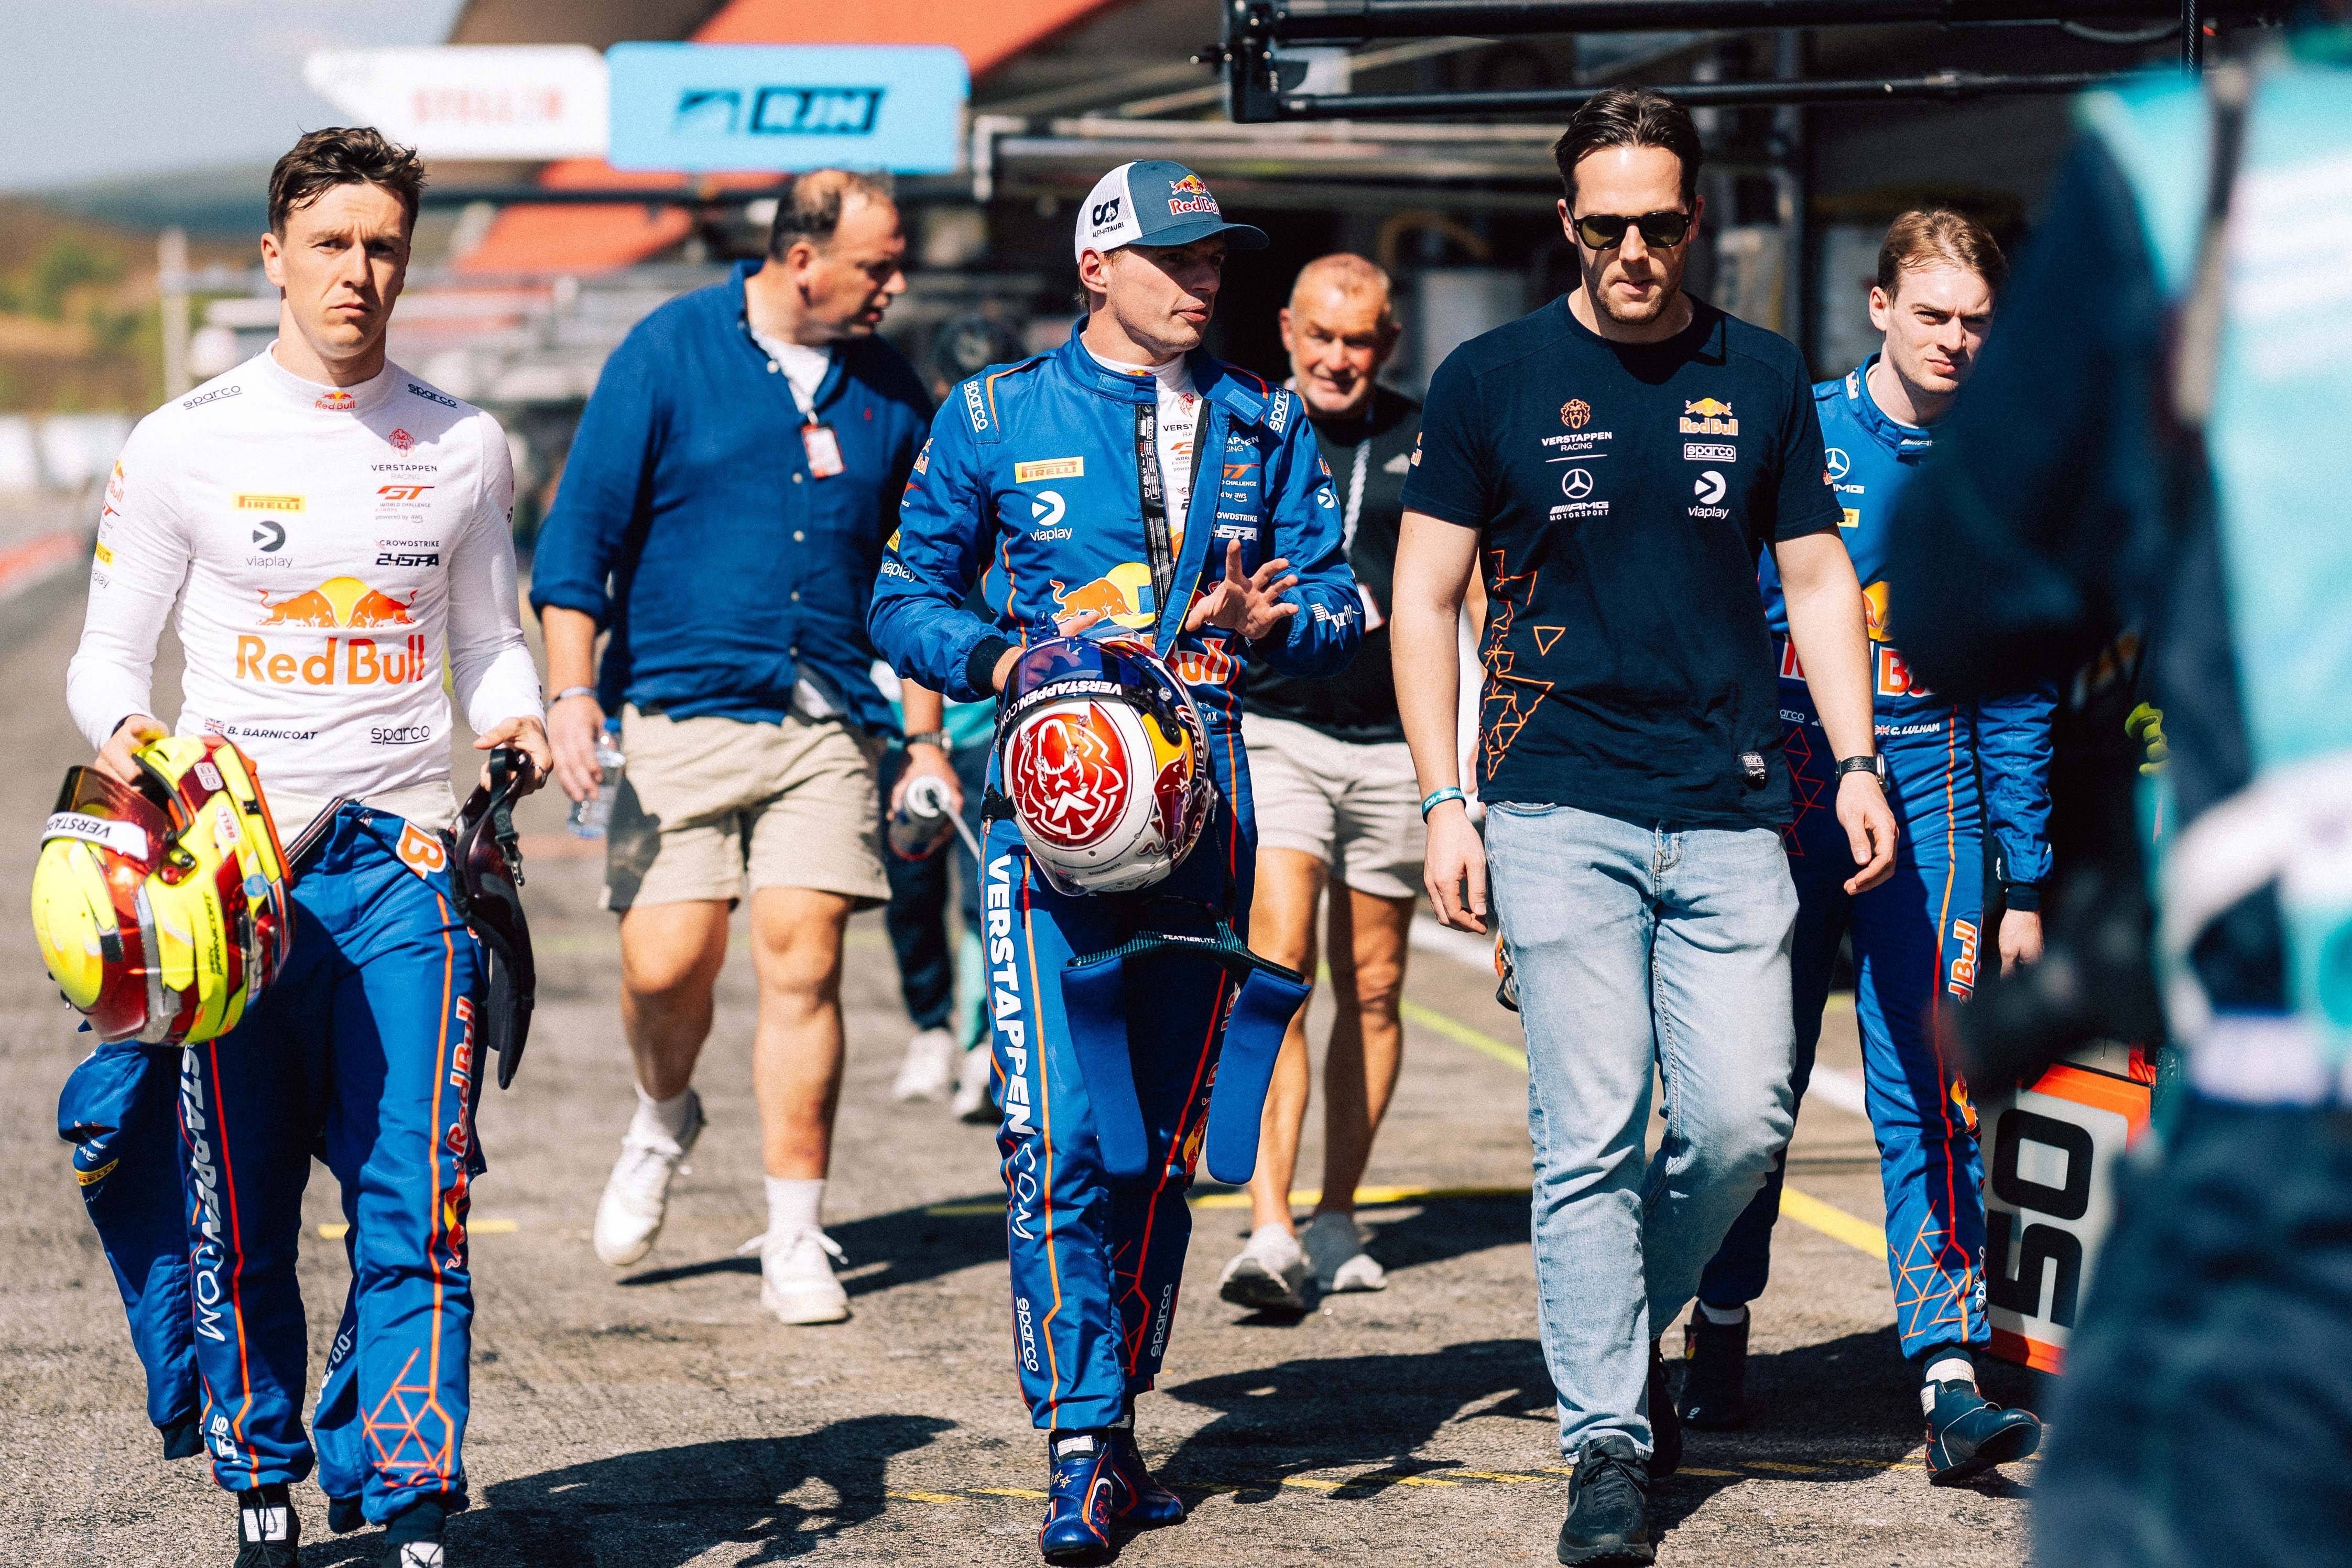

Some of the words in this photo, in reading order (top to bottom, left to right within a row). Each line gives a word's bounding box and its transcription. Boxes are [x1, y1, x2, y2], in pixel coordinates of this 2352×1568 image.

[1168, 195, 1201, 216] Red
[183, 386, 242, 410] sparco
[408, 383, 458, 408] sparco
[315, 400, 335, 410] Red
[336, 400, 355, 409] Bull
[963, 380, 988, 433] sparco
[1269, 387, 1290, 433] sparco
[1680, 417, 1709, 433] Red
[1710, 419, 1738, 436] Bull
[1542, 431, 1612, 446] VERSTAPPEN
[1561, 442, 1593, 451] RACING
[1687, 444, 1734, 459] sparco
[1022, 461, 1077, 478] PIRELLI
[1833, 484, 1865, 494] MG
[238, 495, 301, 510] PIRELLI
[1567, 500, 1609, 510] AMG
[1216, 512, 1258, 522] OWDSTRIKE
[1550, 509, 1609, 521] MOTORSPORT
[1688, 505, 1729, 519] viaplay
[1030, 527, 1073, 542] viaplay
[246, 556, 293, 569] viaplay
[881, 560, 917, 582] viaplay
[236, 635, 337, 685] Red
[347, 634, 424, 685] Bull
[1780, 709, 1804, 723] arco
[227, 725, 239, 735] B.
[242, 727, 318, 740] BARNICOAT
[371, 725, 430, 745] sparco
[1890, 727, 1900, 735] C.
[1902, 723, 1940, 735] LULHAM
[220, 811, 235, 839] BELL
[1163, 934, 1216, 944] FEATHERLITE
[1986, 1109, 2094, 1328] 50
[1150, 1283, 1172, 1357] sparco
[1016, 1297, 1038, 1371] sparco
